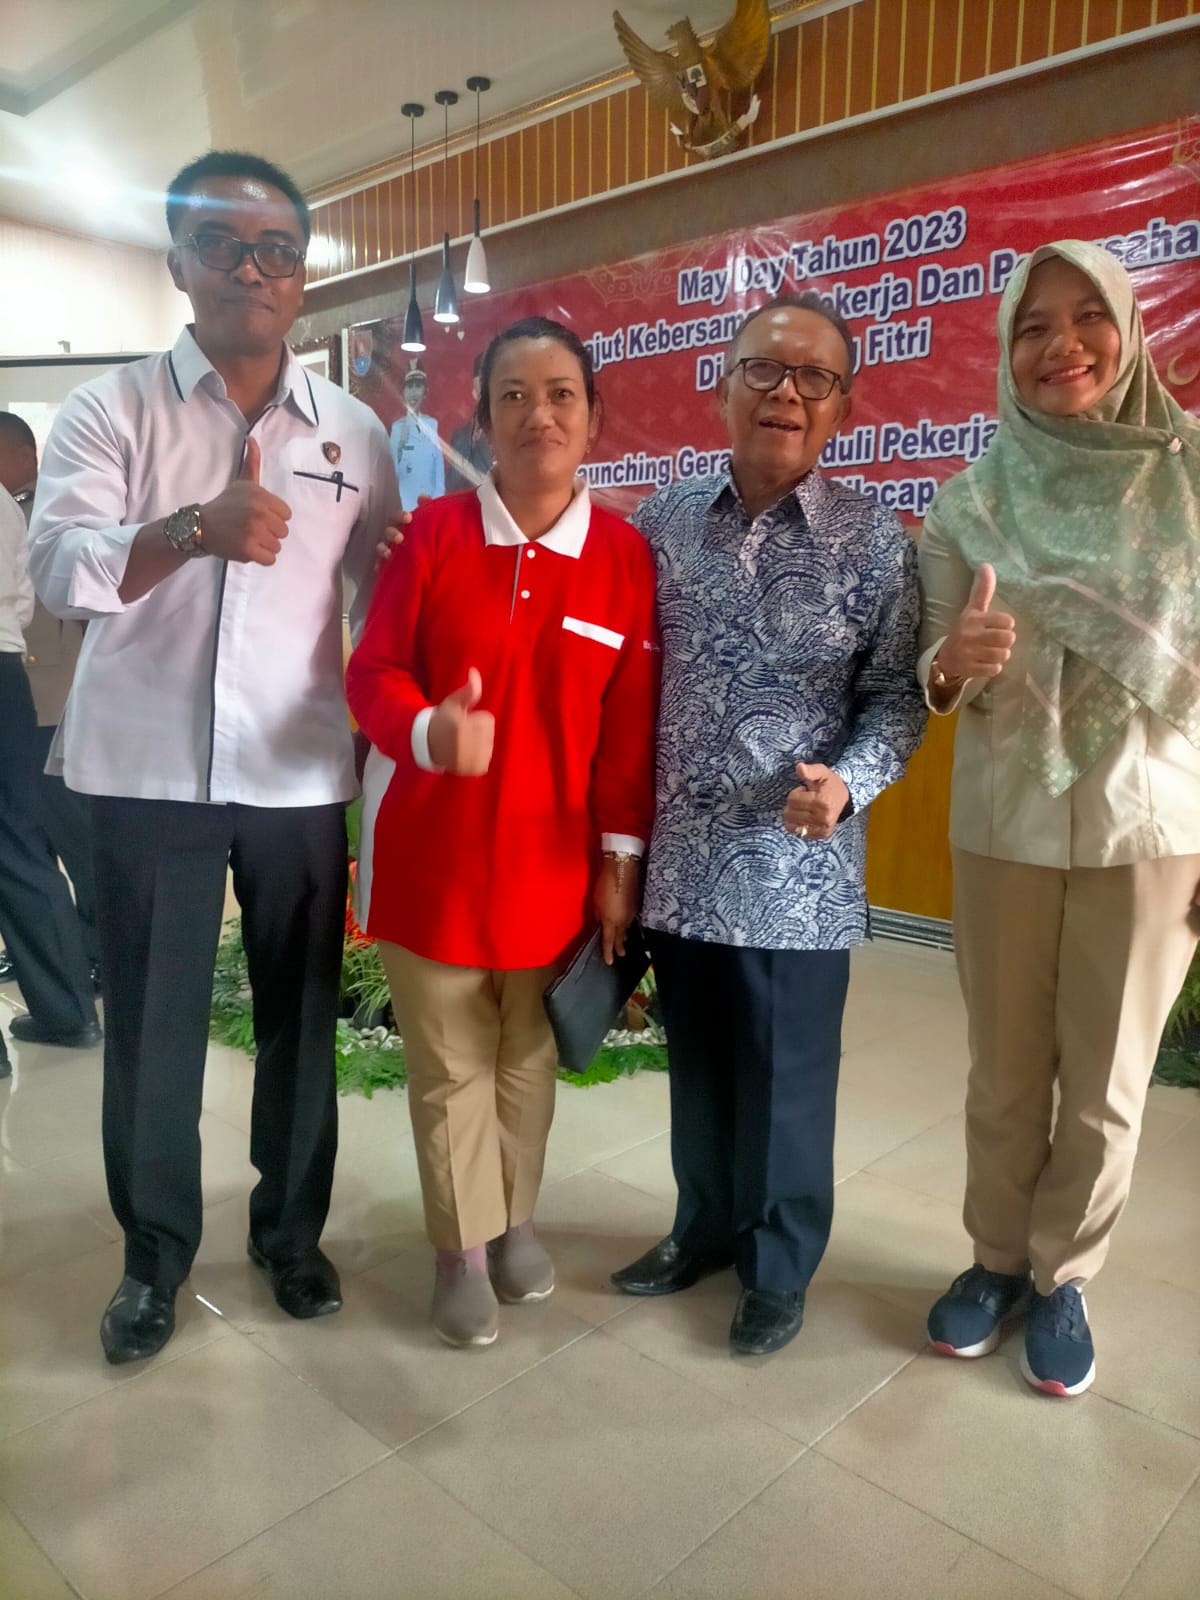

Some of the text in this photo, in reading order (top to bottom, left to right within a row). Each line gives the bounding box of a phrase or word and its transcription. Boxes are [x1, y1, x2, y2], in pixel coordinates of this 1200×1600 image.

[680, 208, 964, 303] May Day Tahun 2023
[919, 265, 982, 304] Dan
[698, 354, 723, 389] Di
[867, 318, 930, 363] Fitri
[677, 447, 732, 478] Gera
[820, 427, 874, 466] duli
